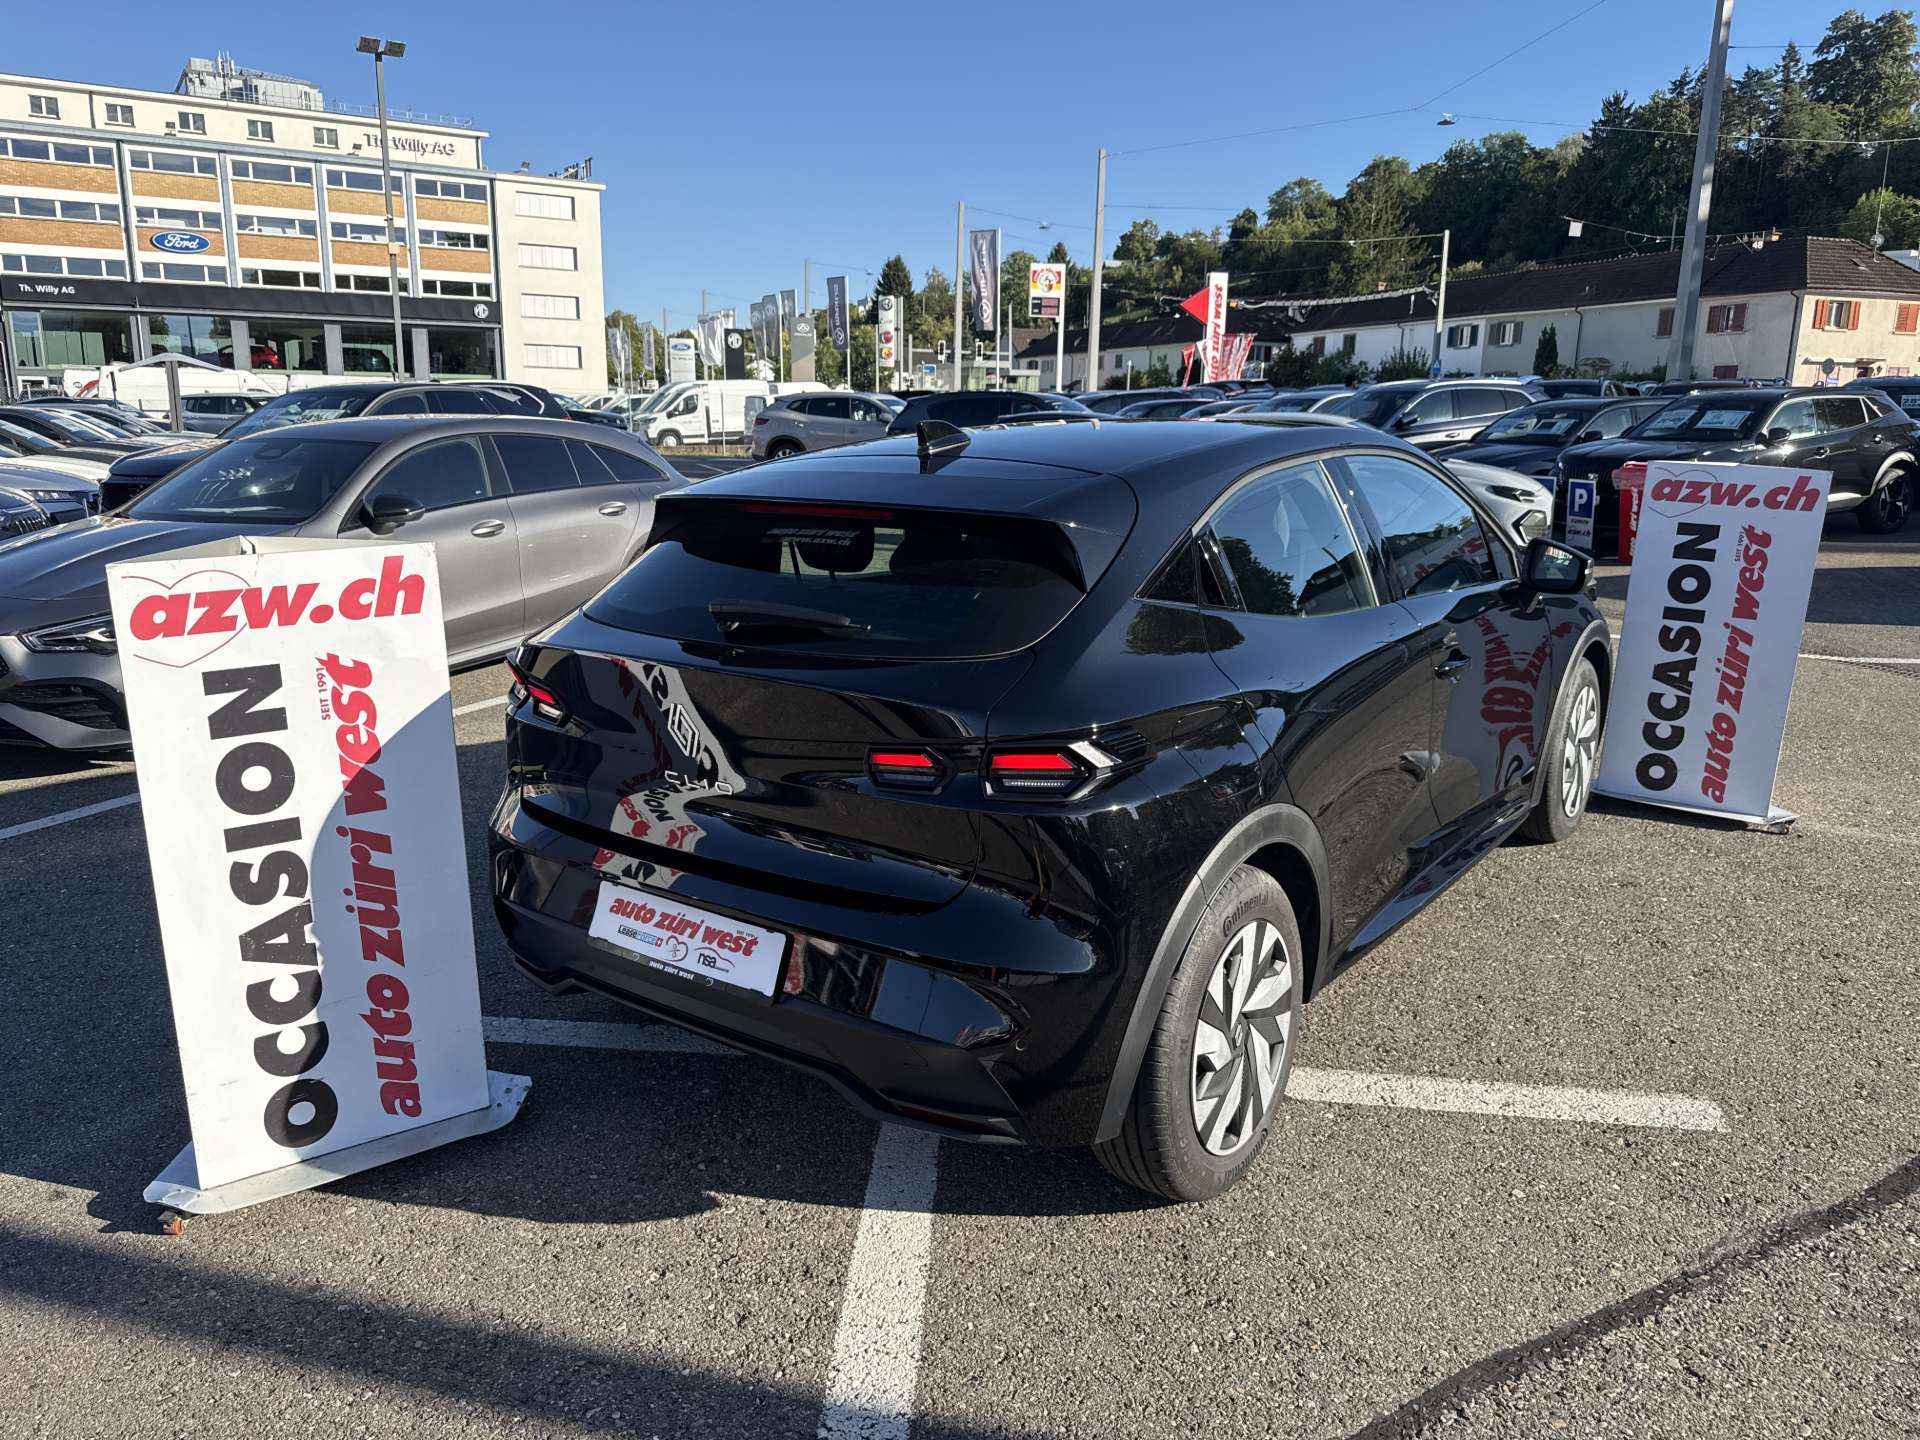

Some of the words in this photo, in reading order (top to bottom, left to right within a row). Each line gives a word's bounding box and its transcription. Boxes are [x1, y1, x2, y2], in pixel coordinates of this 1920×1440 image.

[392, 136, 428, 156] Willy
[432, 142, 455, 156] AG
[164, 233, 199, 249] Ford
[1752, 241, 1764, 249] 48
[18, 283, 34, 292] Th.
[35, 285, 59, 295] Willy
[61, 286, 76, 294] AG
[1574, 488, 1588, 513] P
[1651, 475, 1821, 513] azw.ch
[1731, 524, 1773, 621] west
[129, 555, 426, 641] azw.ch
[315, 667, 328, 694] 1991
[1635, 522, 1721, 792] OCCASION
[1715, 622, 1754, 714] züri
[320, 698, 331, 720] SEIT
[314, 652, 388, 817] west
[1700, 712, 1738, 804] auto
[664, 770, 733, 795] CLIO
[201, 662, 339, 1149] OCCASION
[335, 825, 406, 967] züri
[1222, 889, 1269, 938] Continental
[609, 898, 657, 924] auto
[653, 911, 705, 940] züri
[701, 925, 759, 957] west
[697, 952, 717, 969] nsa
[359, 973, 423, 1118] auto
